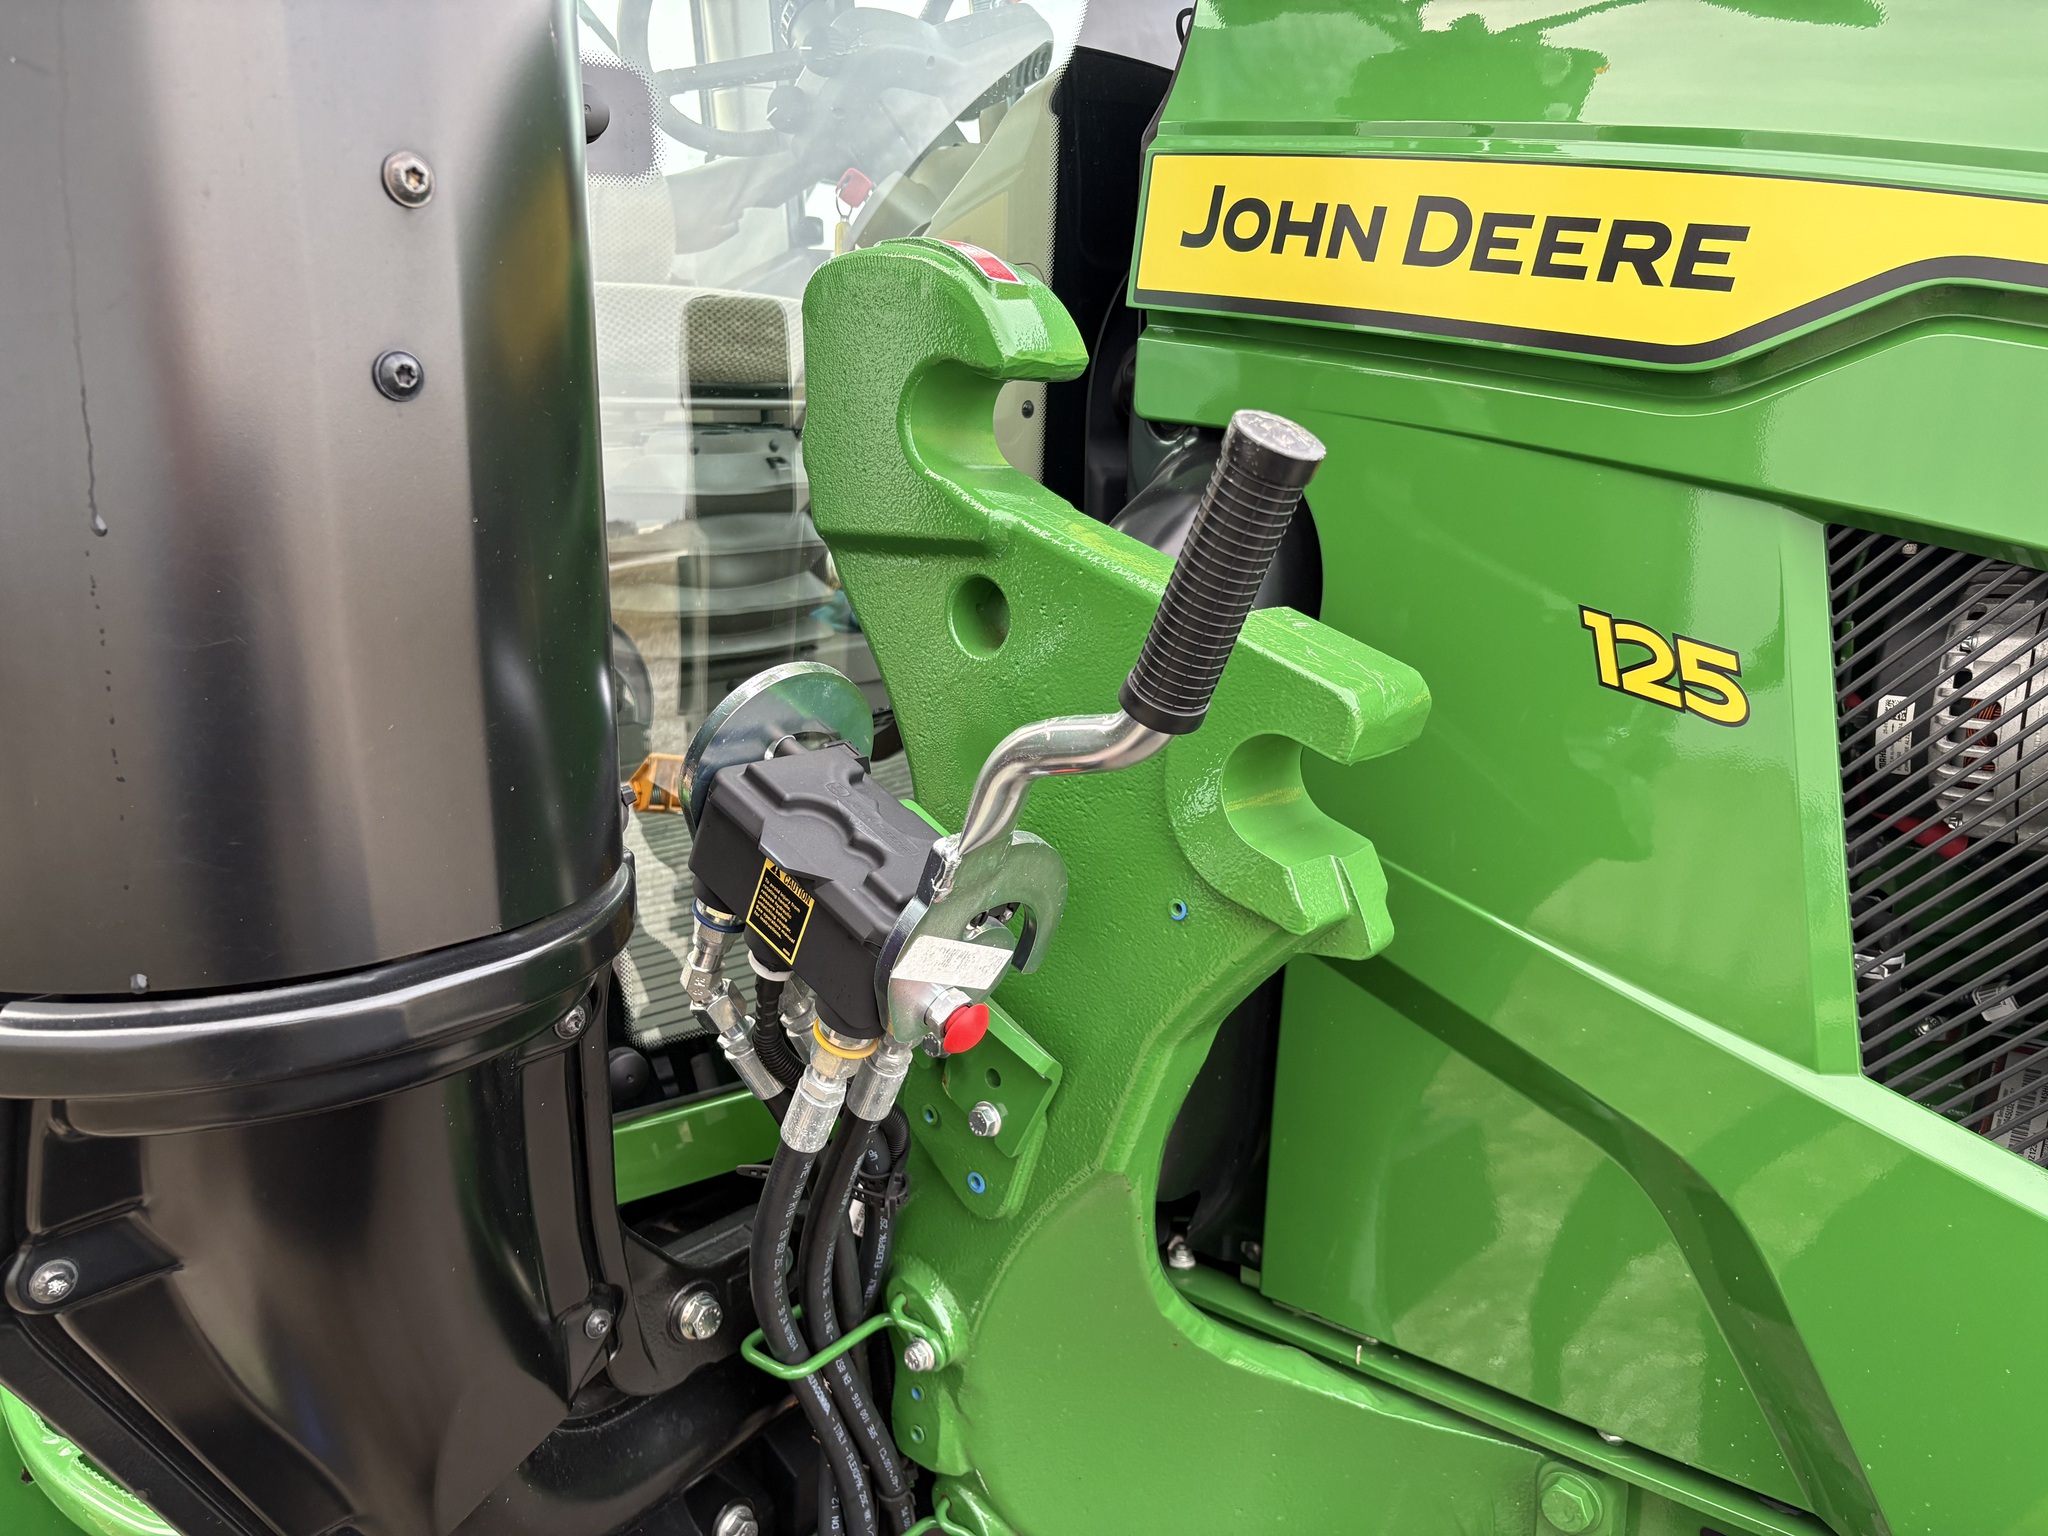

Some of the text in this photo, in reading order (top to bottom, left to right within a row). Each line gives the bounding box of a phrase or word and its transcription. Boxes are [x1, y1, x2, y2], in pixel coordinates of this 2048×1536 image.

[1180, 185, 1750, 292] JOHN DEERE
[1579, 605, 1750, 727] 125
[783, 875, 811, 905] CAUTION
[841, 1374, 852, 1387] EN
[851, 1392, 863, 1410] R16
[859, 1409, 870, 1424] 100
[866, 1425, 879, 1440] SAE
[832, 1421, 846, 1446] ITALY
[846, 1453, 864, 1490] FLEXOPAK
[831, 1497, 840, 1529] DN 12
